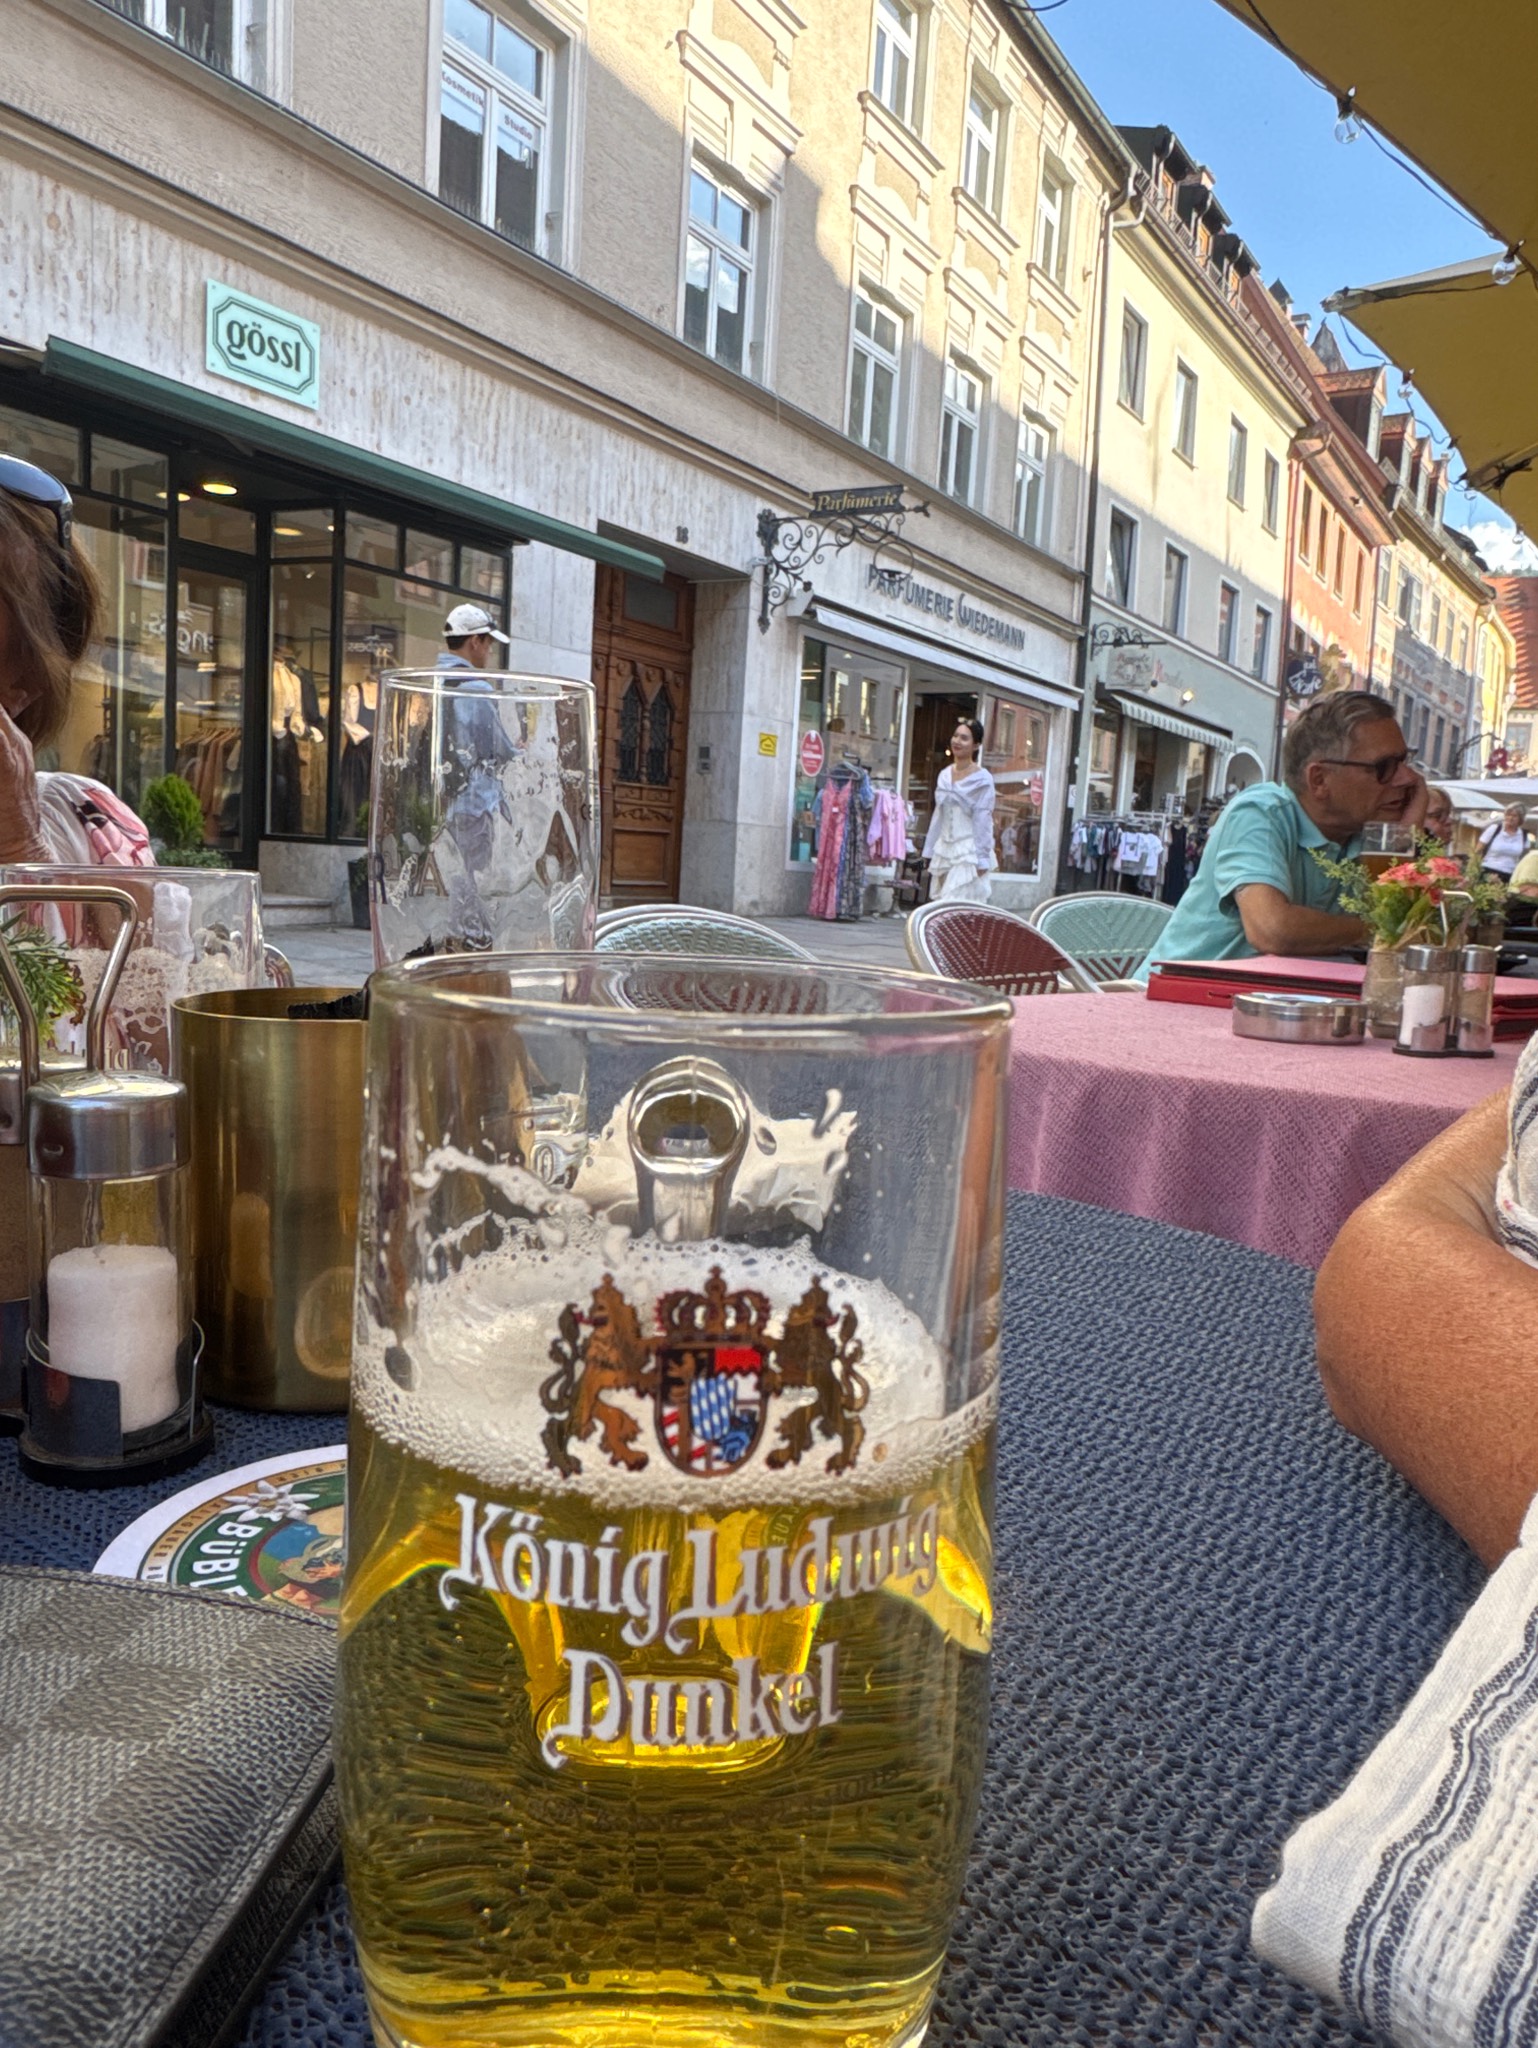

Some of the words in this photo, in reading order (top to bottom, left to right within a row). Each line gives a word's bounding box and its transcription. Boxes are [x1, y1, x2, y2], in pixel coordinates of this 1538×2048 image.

[504, 114, 533, 141] Studio
[226, 319, 302, 373] gössl
[816, 491, 898, 512] Parfümerie
[675, 525, 689, 545] 18
[865, 563, 955, 622] PARFÜMERIE
[956, 592, 1026, 651] WIEDEMANN
[438, 1493, 669, 1648] König
[664, 1494, 939, 1656] Ludwig
[540, 1640, 844, 1771] Dunkel
